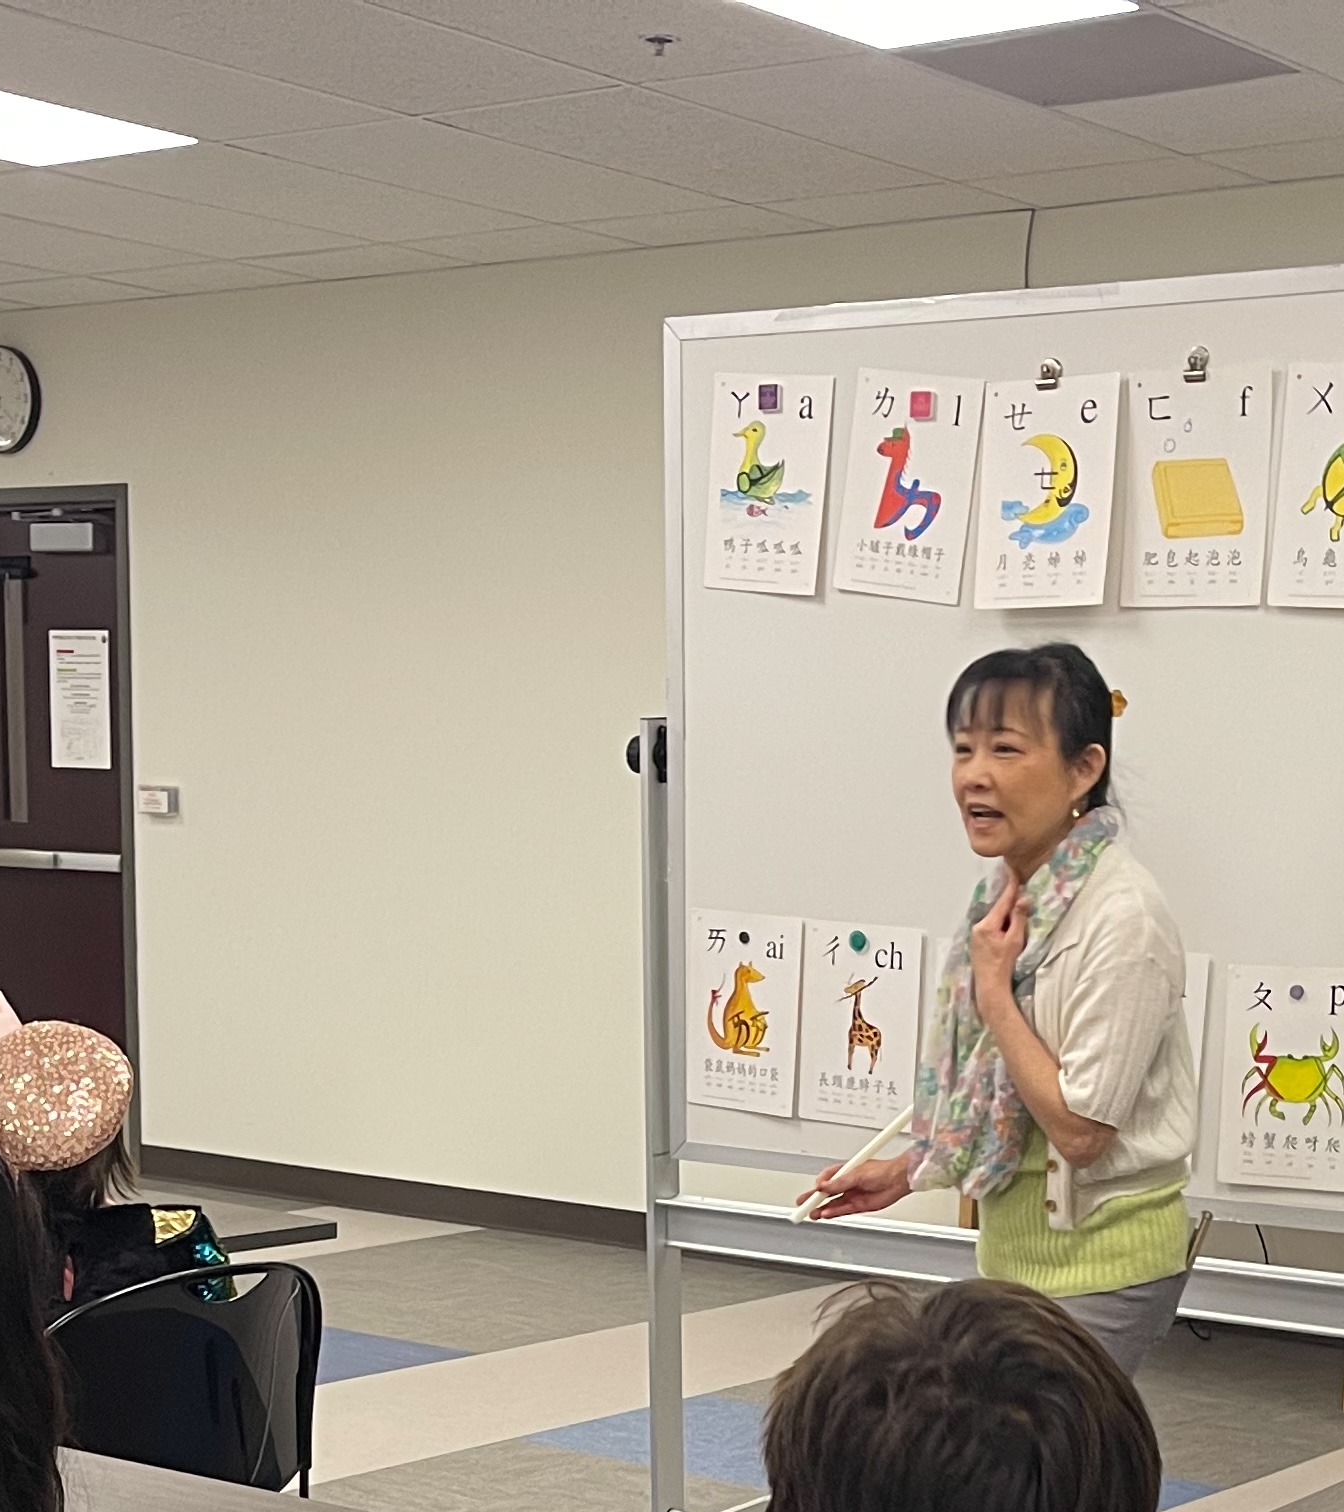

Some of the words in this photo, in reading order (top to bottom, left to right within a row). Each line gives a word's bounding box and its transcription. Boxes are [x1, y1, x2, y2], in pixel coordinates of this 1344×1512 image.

[799, 395, 813, 419] a
[1080, 399, 1098, 424] e
[1239, 385, 1253, 417] f
[766, 934, 784, 960] ai
[874, 941, 904, 971] ch
